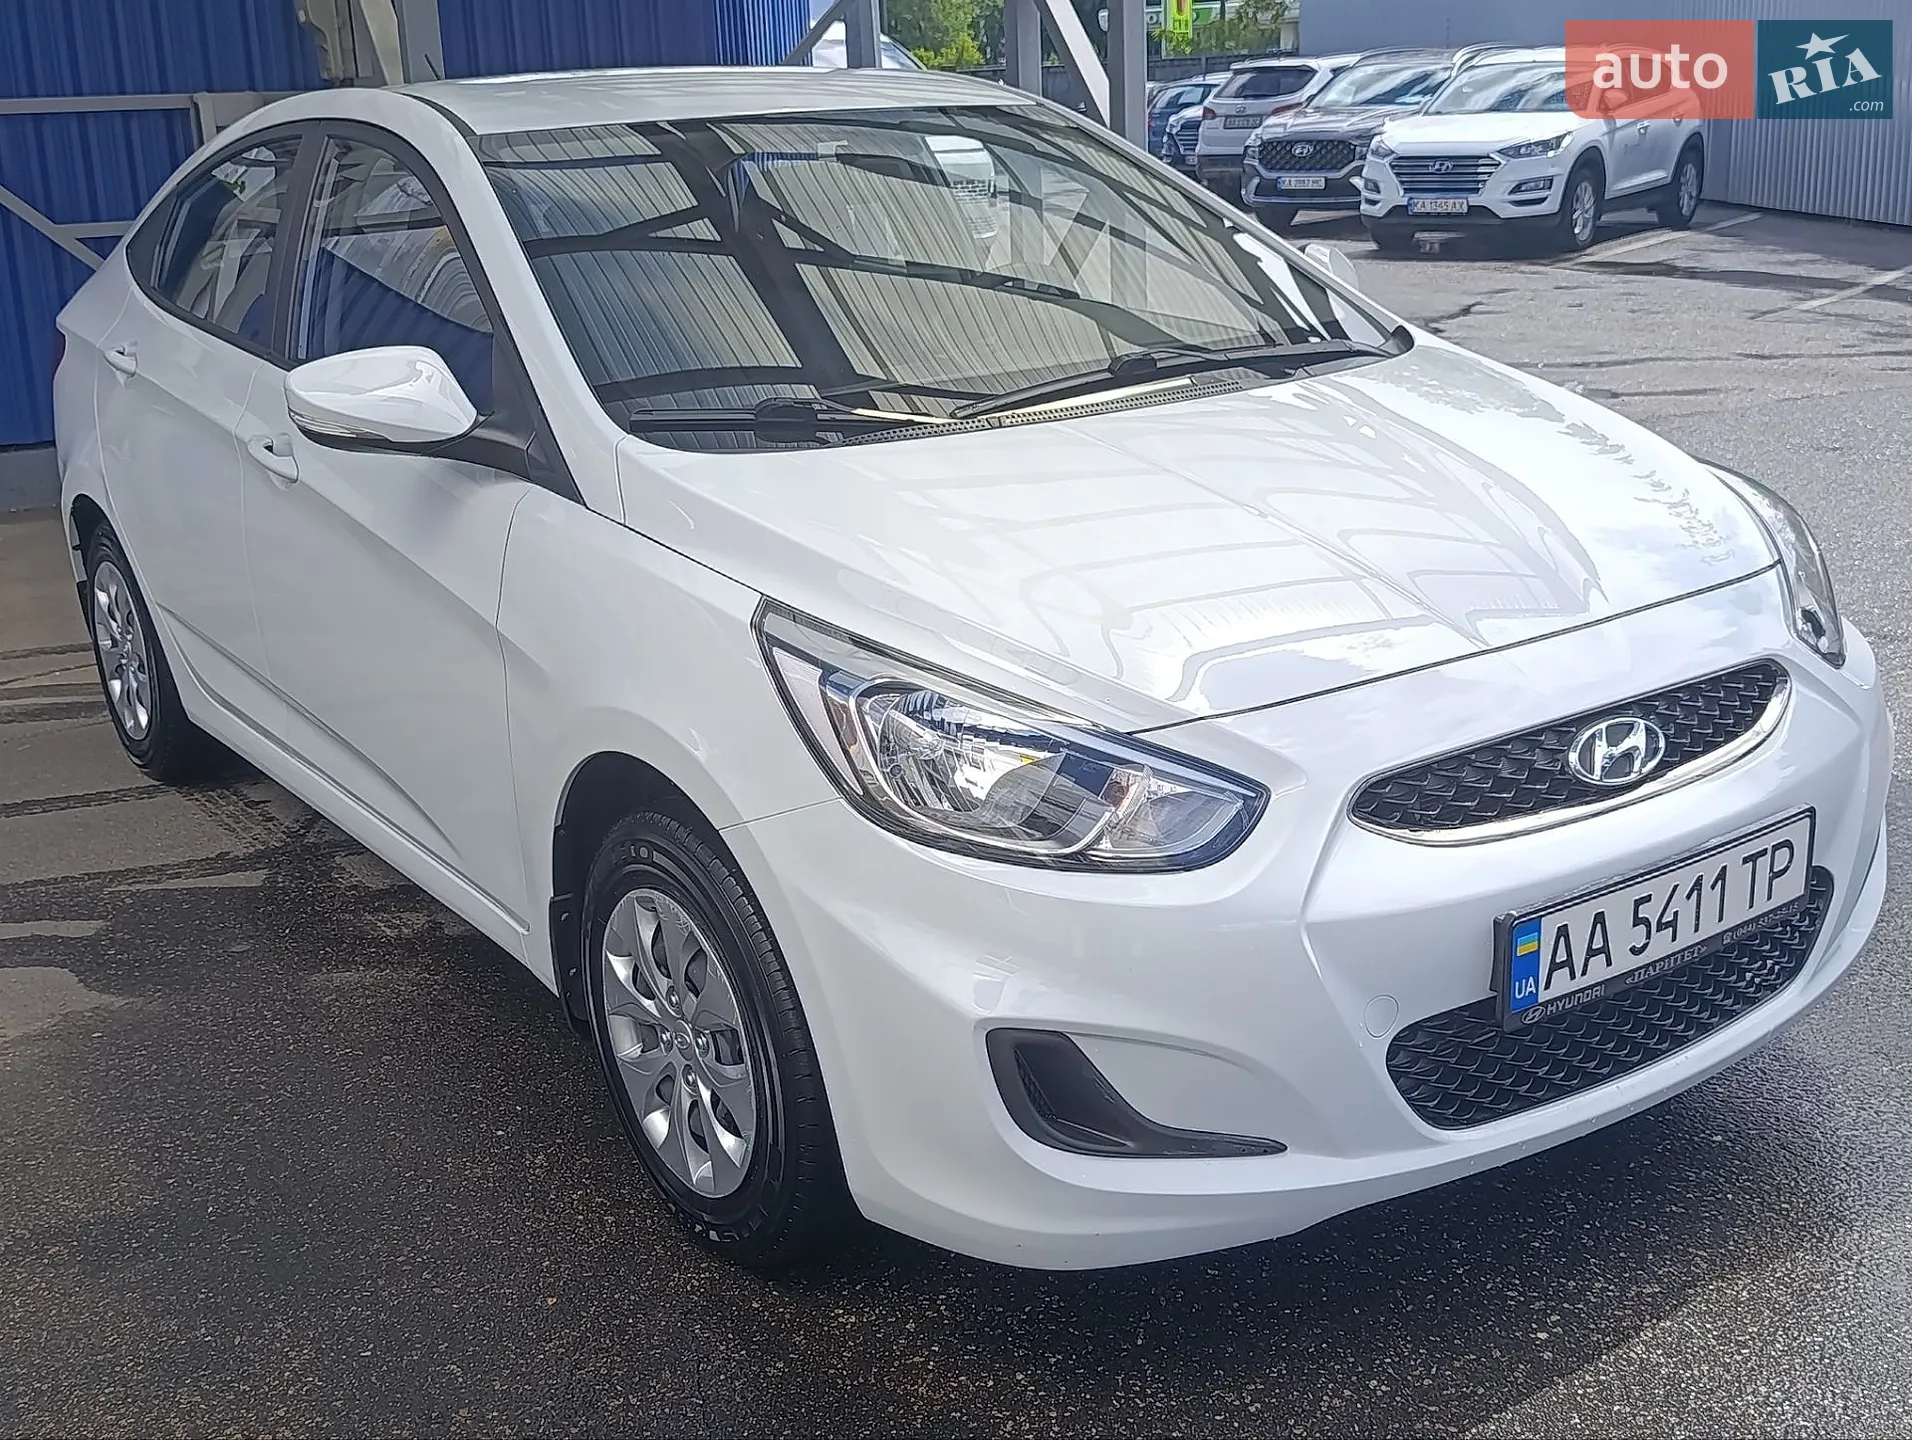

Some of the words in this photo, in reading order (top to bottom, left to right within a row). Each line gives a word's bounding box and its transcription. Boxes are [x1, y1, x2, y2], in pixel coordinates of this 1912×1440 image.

[1413, 201, 1426, 211] KA
[1430, 201, 1449, 211] 1345
[1451, 201, 1465, 211] AX
[1543, 910, 1613, 991] AA
[1628, 864, 1728, 956] 5411
[1741, 838, 1796, 909] TP
[1515, 976, 1536, 999] UA
[1546, 984, 1605, 1016] HYUNDAI
